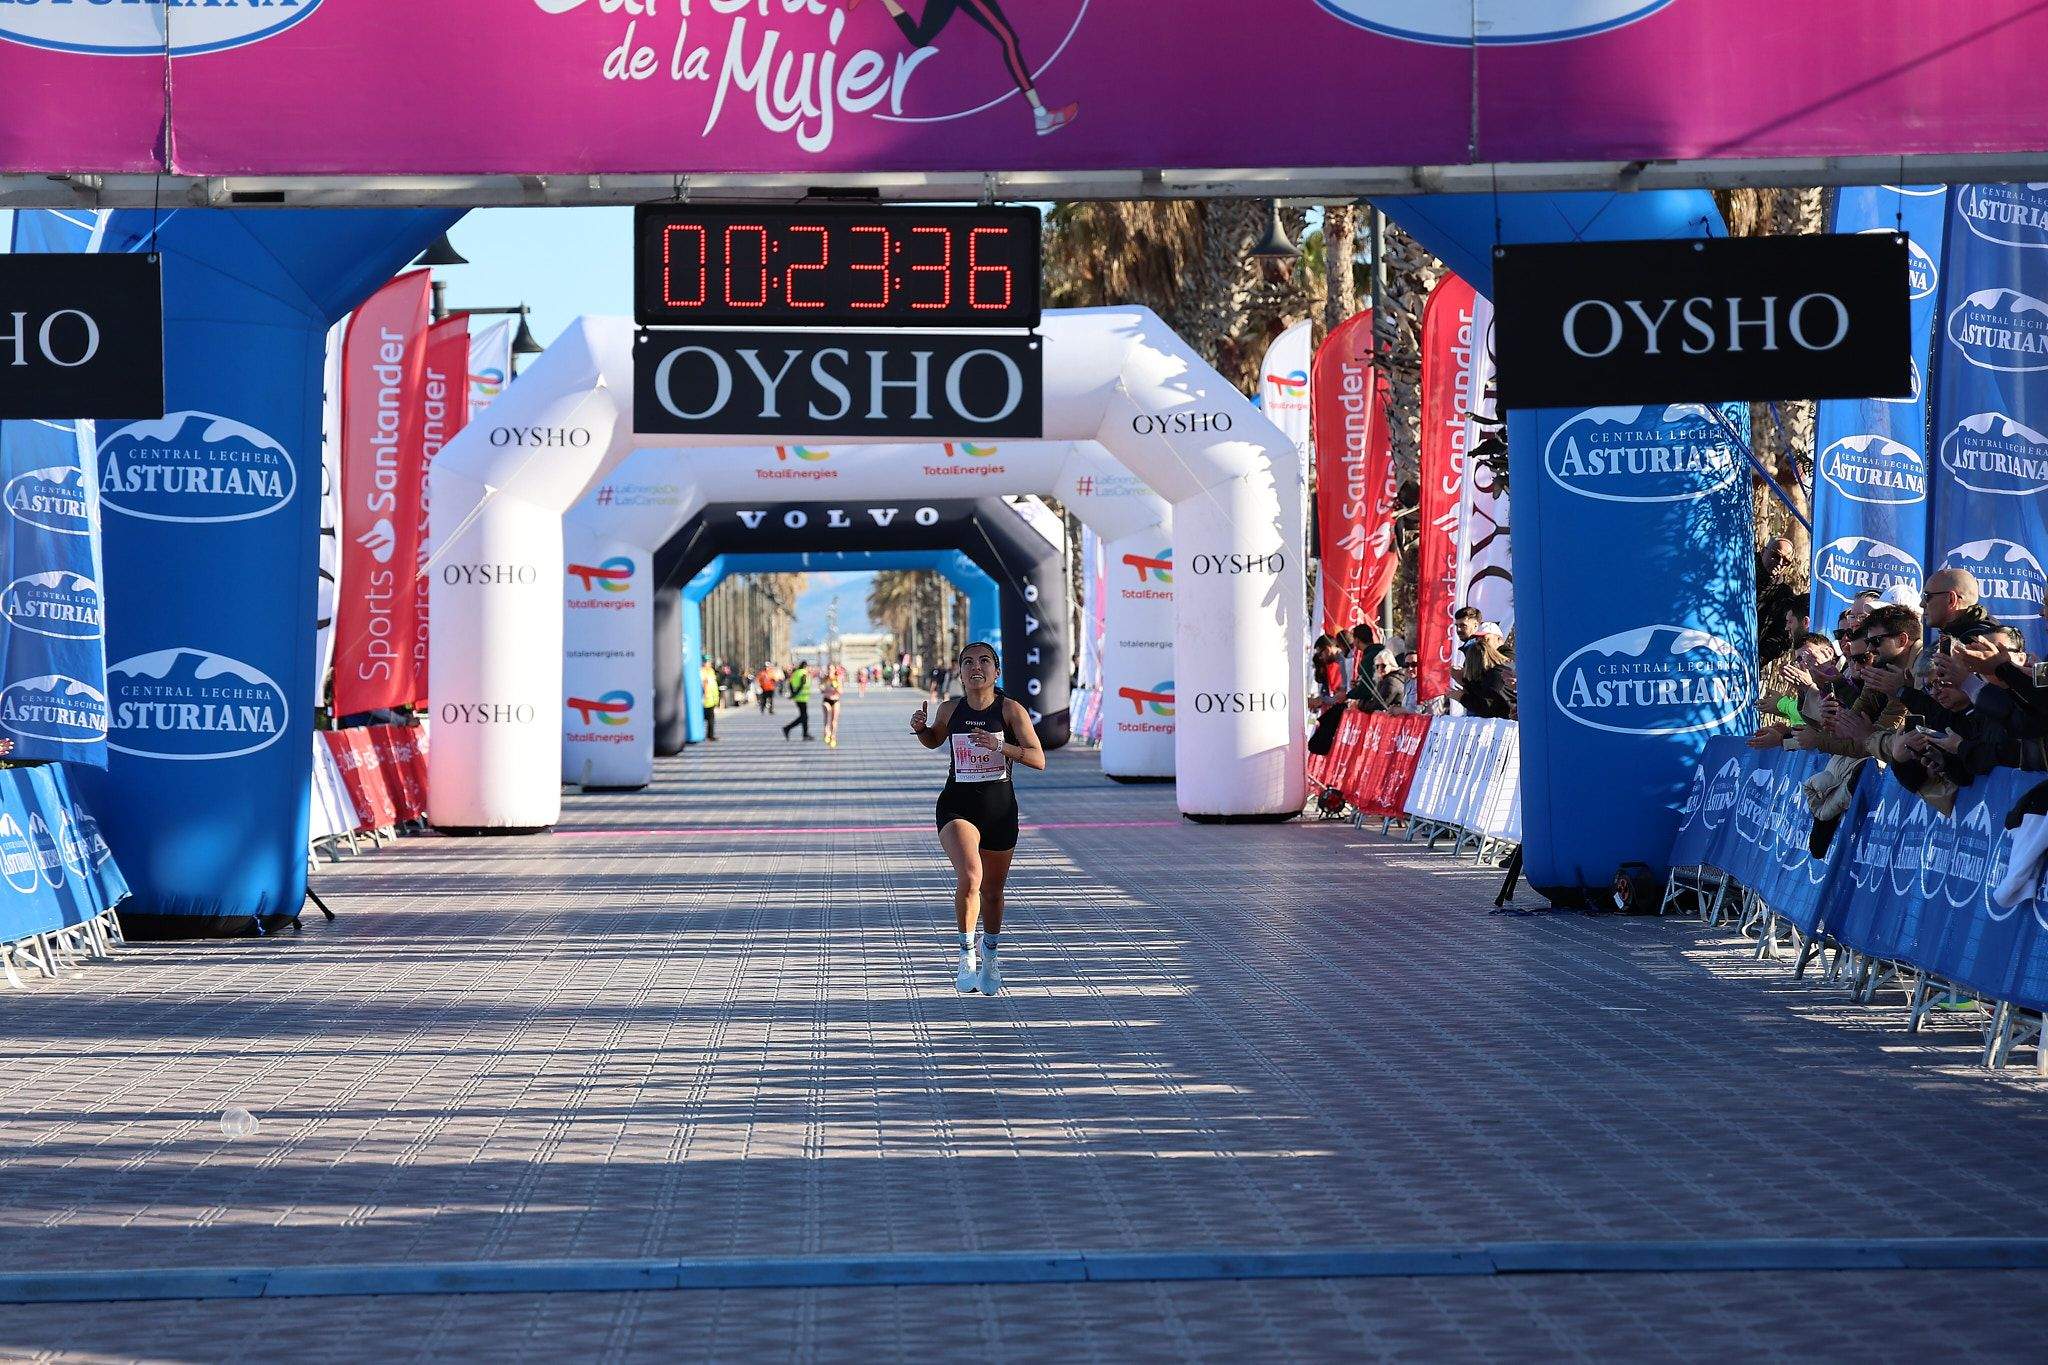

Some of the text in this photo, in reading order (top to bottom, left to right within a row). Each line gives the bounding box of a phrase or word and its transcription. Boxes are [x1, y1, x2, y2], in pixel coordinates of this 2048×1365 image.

[603, 15, 938, 153] de la Mujer
[1982, 186, 2025, 200] CENTRAL
[663, 224, 1013, 310] 00:23:36
[1562, 293, 1850, 357] OYSHO
[1970, 312, 2009, 325] CENTRAL
[653, 345, 1024, 424] OYSHO
[1132, 411, 1232, 435] OYSHO
[490, 426, 591, 448] OYSHO
[1338, 362, 1367, 520] Santander
[1590, 430, 1663, 443] CENTRAL
[1964, 436, 2002, 449] CENTRAL
[129, 448, 279, 465] CENTRAL LECHERA
[1841, 453, 1880, 465] CENTRAL
[101, 451, 284, 498] ASTURIANA
[756, 468, 838, 480] TotalEnergies
[923, 464, 1005, 477] TotalEnergies
[1828, 451, 1924, 494] ASTURIANA
[34, 485, 77, 497] CENTRAL
[359, 326, 404, 681] Sports Santander
[736, 507, 940, 529] VOLVO
[443, 563, 537, 586] OYSHO
[1192, 552, 1285, 576] OYSHO
[1870, 561, 1917, 574] LECHERA
[1962, 563, 2004, 575] ENTRAL
[27, 590, 70, 601] CENTRAL
[567, 599, 635, 610] TotalEnergies
[1024, 584, 1042, 726] VOLVO
[1598, 663, 1670, 675] CENTRAL
[121, 685, 272, 700] CENTRAL LECHERA
[1567, 668, 1744, 708] ASTURIANA
[1194, 690, 1287, 714] OYSHO
[442, 702, 535, 725] OYSHO
[566, 732, 635, 744] TotalEnergies
